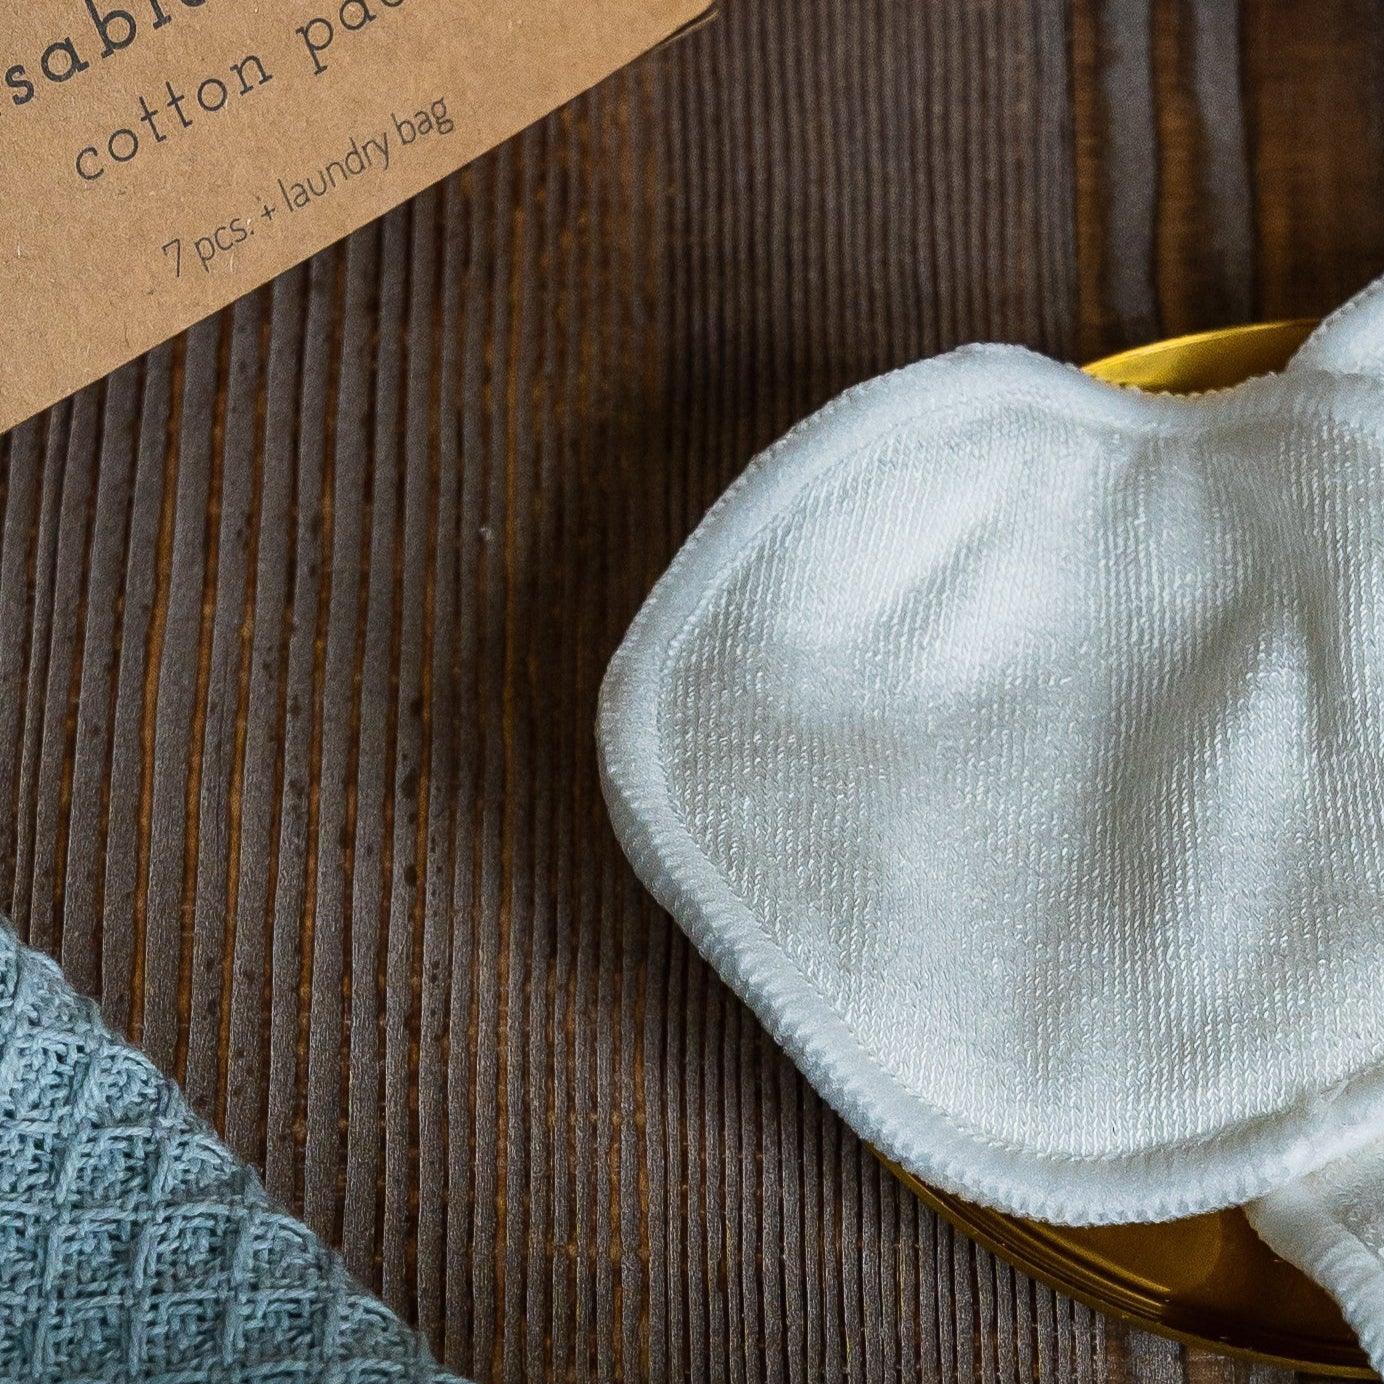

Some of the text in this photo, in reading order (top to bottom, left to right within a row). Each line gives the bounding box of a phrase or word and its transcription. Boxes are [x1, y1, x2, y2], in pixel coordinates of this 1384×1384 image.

[5, 0, 207, 105] sab
[75, 0, 402, 181] cotton pa
[162, 238, 181, 277] 7
[194, 217, 254, 273] pcs.
[278, 132, 390, 212] laundry
[390, 97, 454, 145] bag
